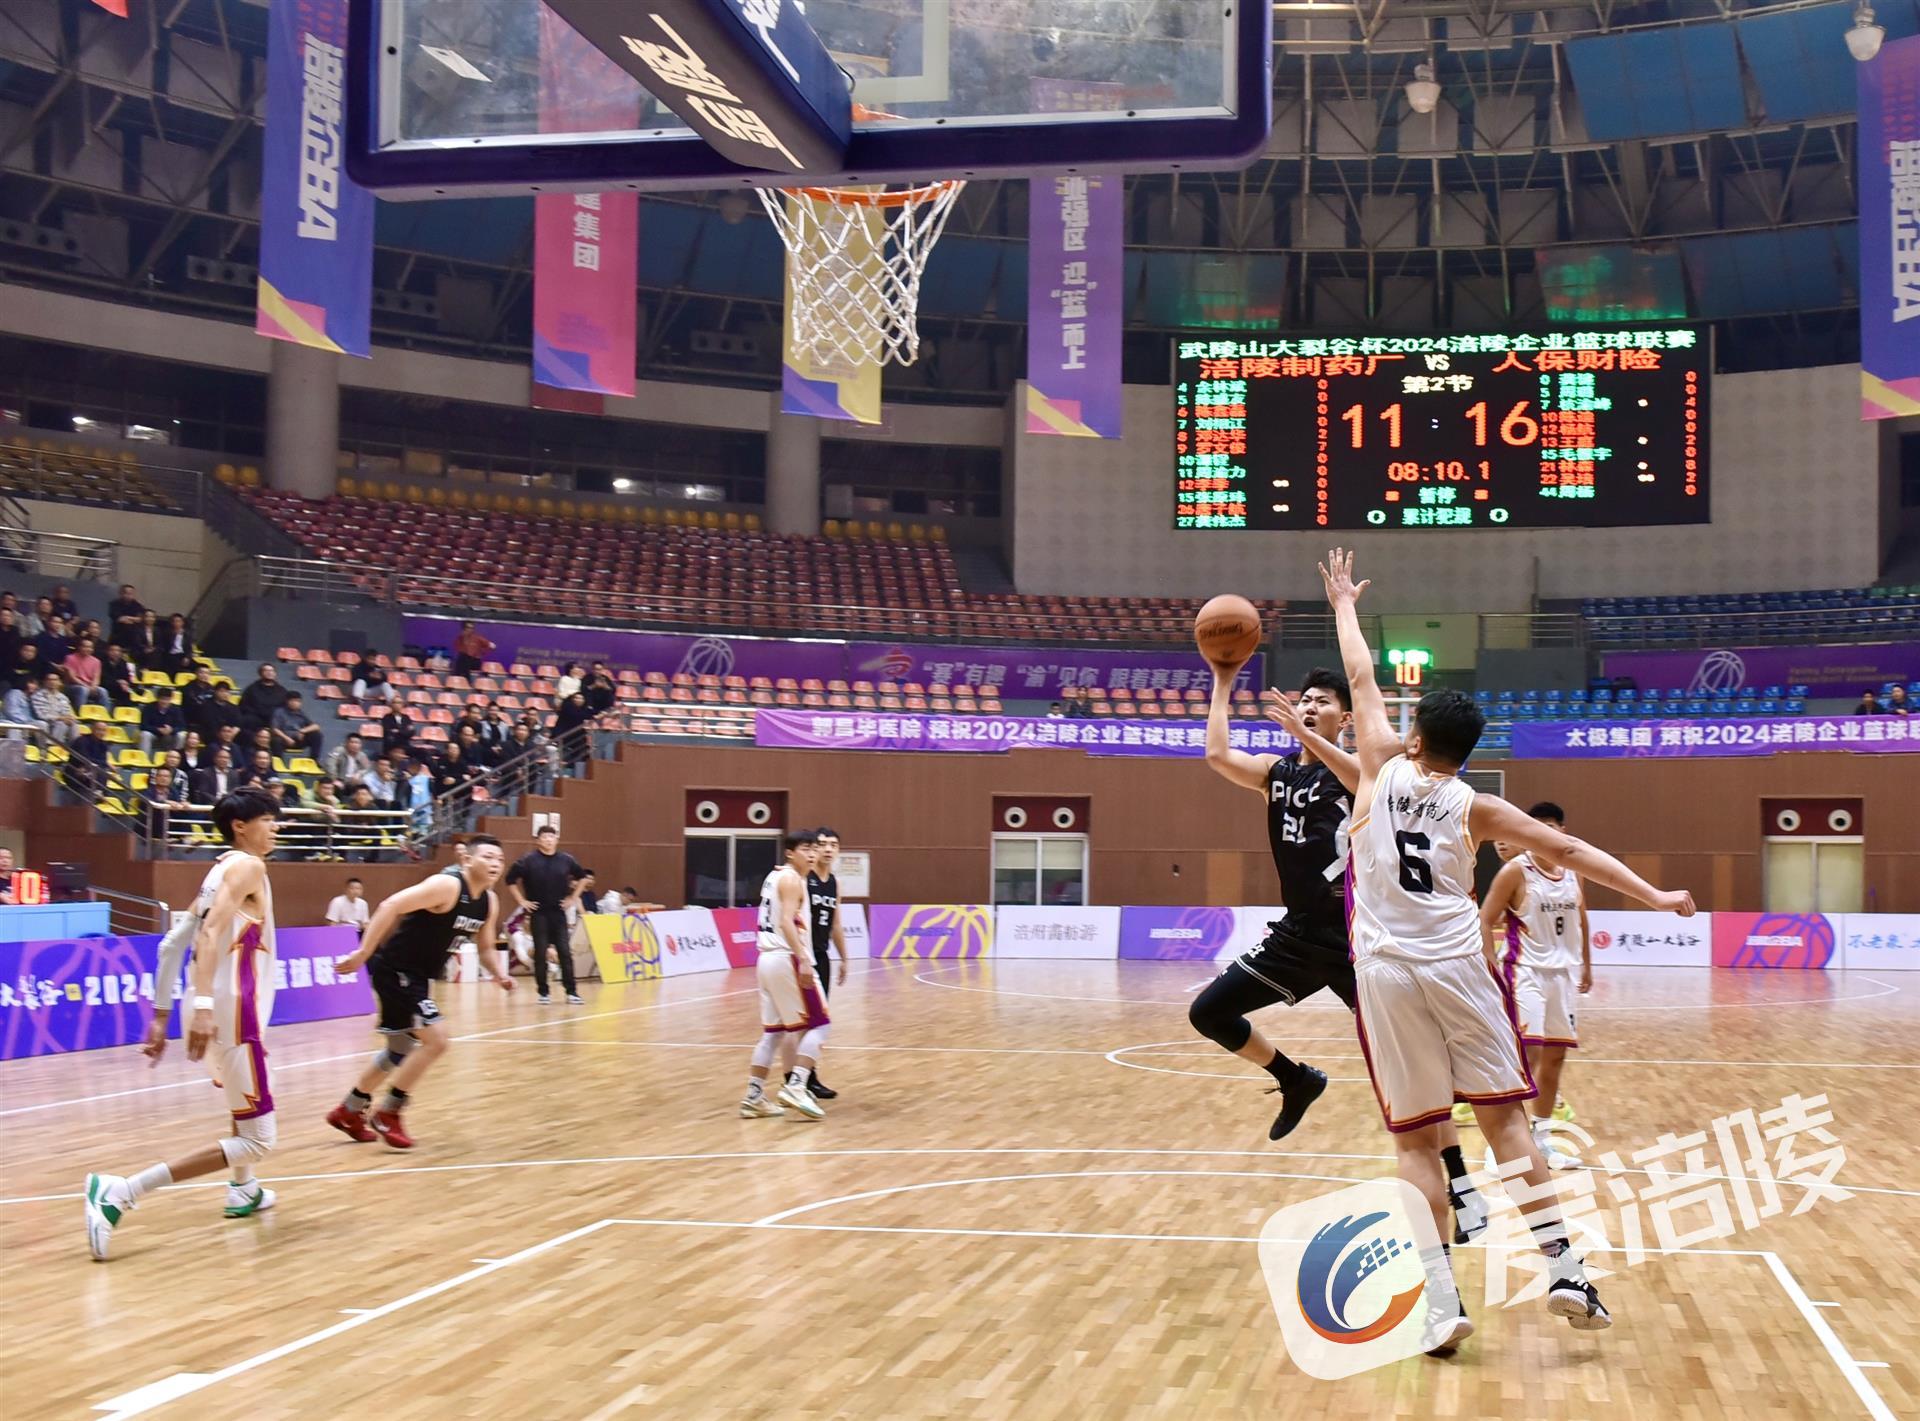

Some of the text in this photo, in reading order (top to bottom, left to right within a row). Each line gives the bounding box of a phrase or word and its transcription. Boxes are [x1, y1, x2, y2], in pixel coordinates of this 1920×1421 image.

[1178, 331, 1697, 359] 武陵山大裂谷杯2024涪陵企业篮球联赛
[1199, 348, 1662, 379] 涪陵制药厂 VS 人保财险
[1177, 382, 1188, 392] 4
[1401, 374, 1474, 394] 第2节
[1177, 394, 1188, 405] 5
[1177, 405, 1188, 418] 6
[1177, 418, 1188, 430] 7
[1341, 402, 1403, 449] 11
[1464, 401, 1539, 448] 16
[1177, 430, 1188, 442] 8
[1177, 442, 1188, 454] 9
[1178, 454, 1194, 466] 10
[1178, 466, 1194, 478] 11
[1178, 492, 1194, 504] 15
[1418, 486, 1457, 504] 暂停
[1178, 504, 1194, 515] 26
[1178, 516, 1194, 528] 27
[1108, 668, 1252, 691] 跟着赛事去行
[1396, 664, 1421, 685] 10
[928, 719, 1300, 749] 预祝2024涪陵企业篮球联赛满成功
[1565, 726, 1653, 748] 太极集团
[1271, 780, 1321, 809] PICC
[1282, 812, 1307, 844] 21
[1396, 829, 1433, 893] 6
[818, 910, 830, 926] 2
[1556, 916, 1564, 936] 8
